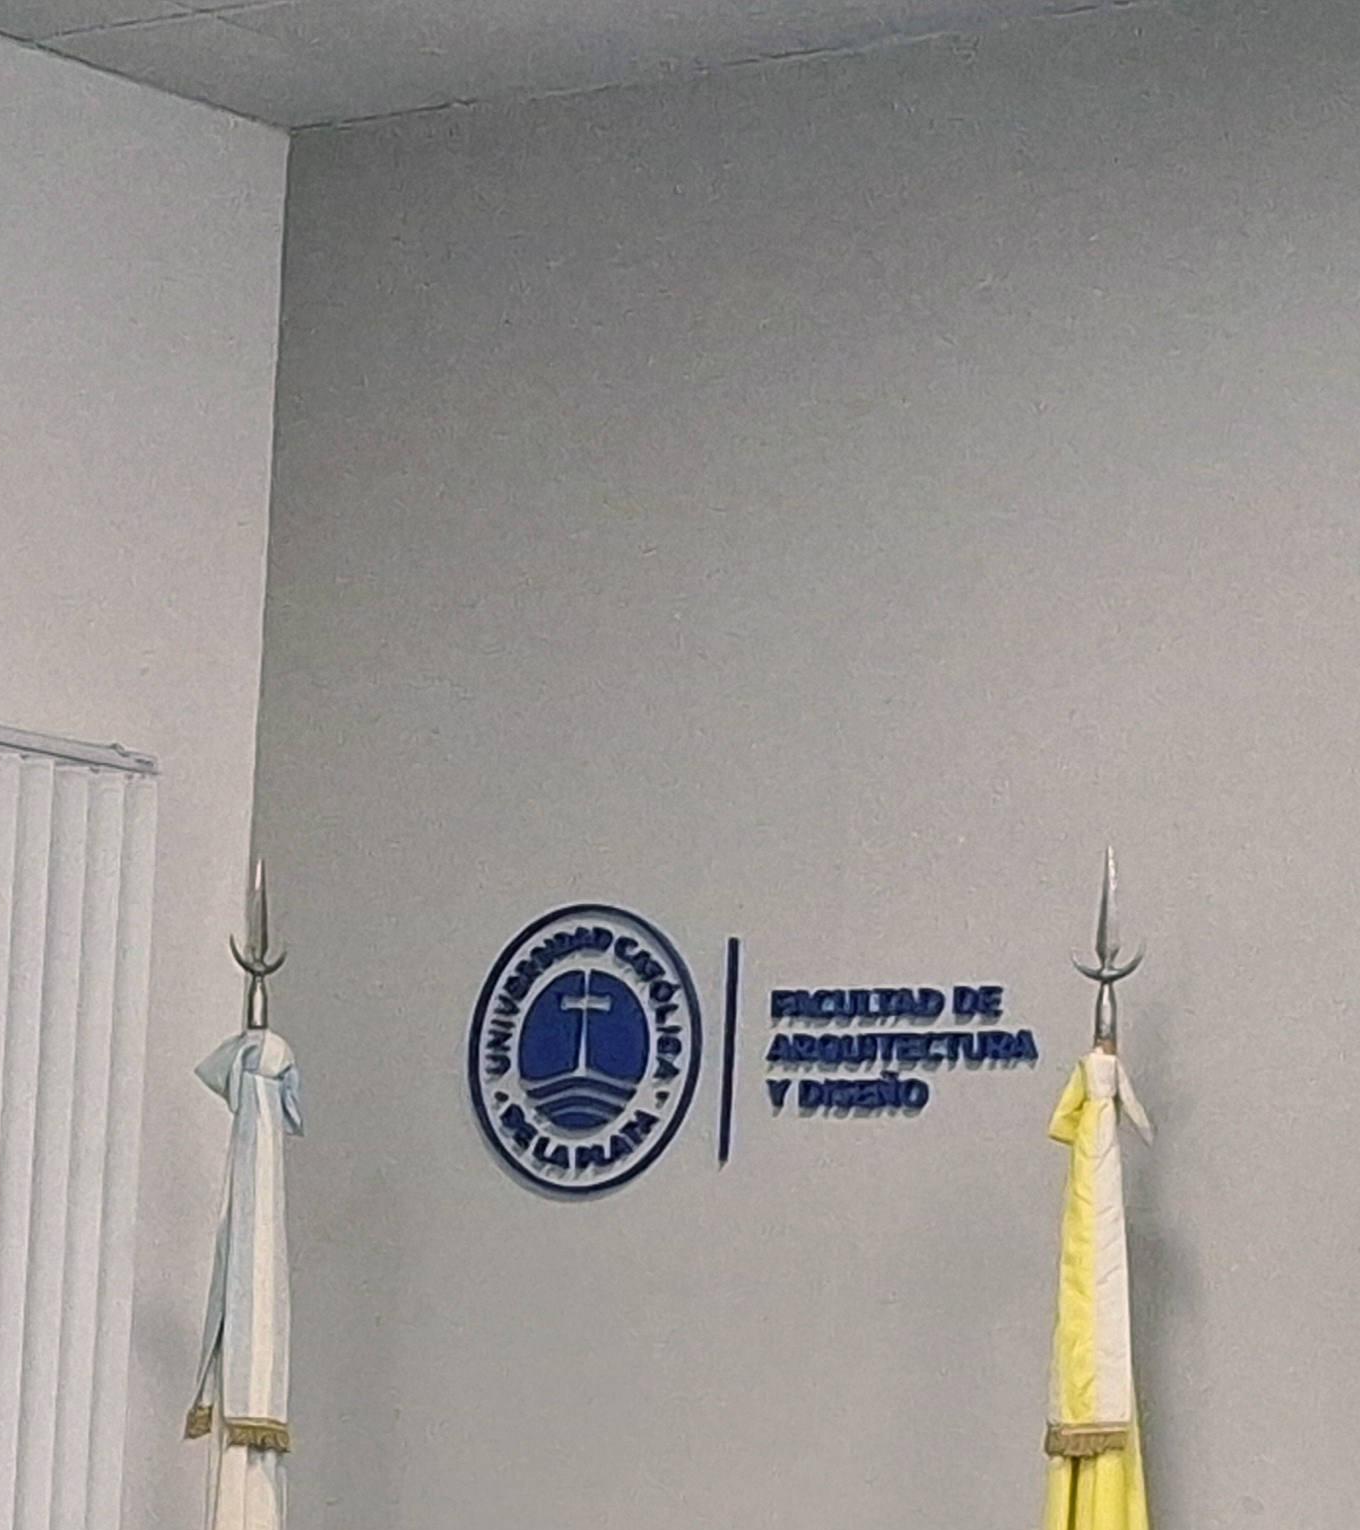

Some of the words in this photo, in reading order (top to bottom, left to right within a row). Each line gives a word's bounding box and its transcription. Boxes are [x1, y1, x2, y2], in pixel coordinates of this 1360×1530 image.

[770, 988, 946, 1018] FACULTAD
[952, 985, 1003, 1016] DE
[765, 1029, 1038, 1063] ARQUITECTURA
[765, 1078, 791, 1107] Y
[798, 1070, 930, 1109] DISEÑO
